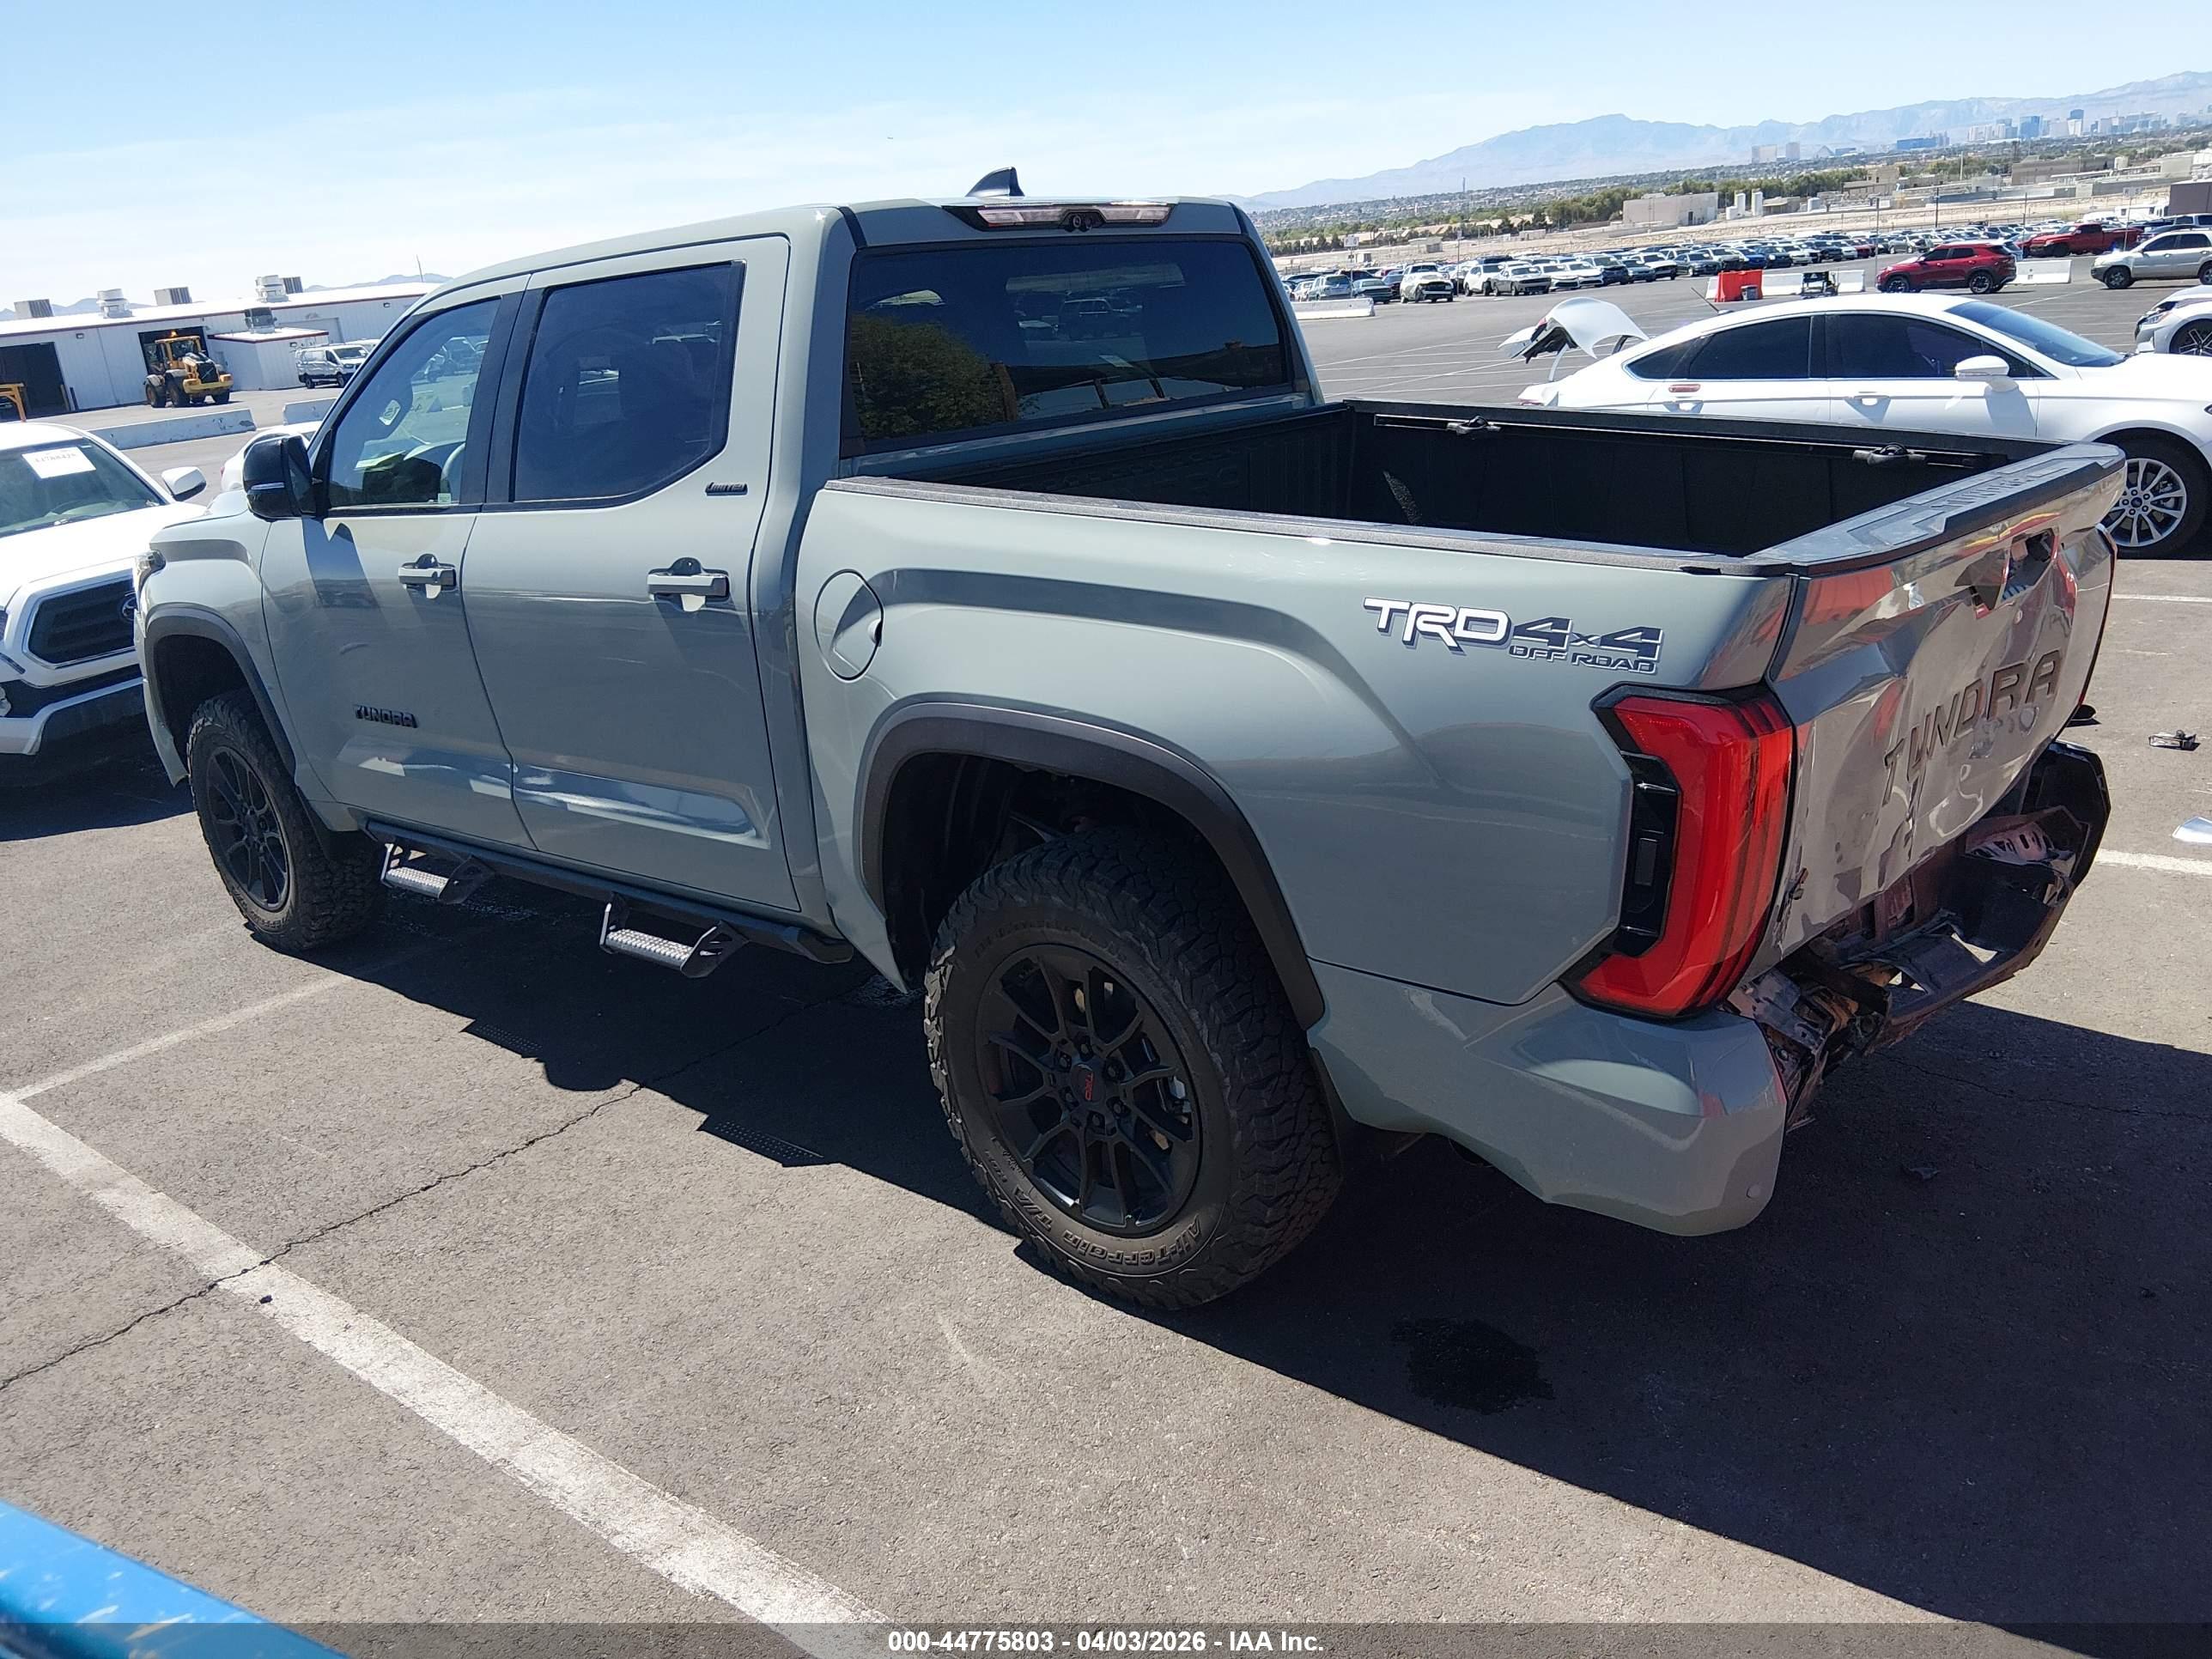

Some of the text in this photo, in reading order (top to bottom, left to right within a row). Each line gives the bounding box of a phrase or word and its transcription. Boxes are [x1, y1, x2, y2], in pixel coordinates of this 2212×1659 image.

[1363, 596, 1664, 663] TRD 4x4
[1509, 644, 1658, 675] OFF ROAD
[352, 703, 419, 729] TUNDRA
[1882, 649, 2063, 807] TUNDRA
[1085, 1072, 1094, 1102] TRD
